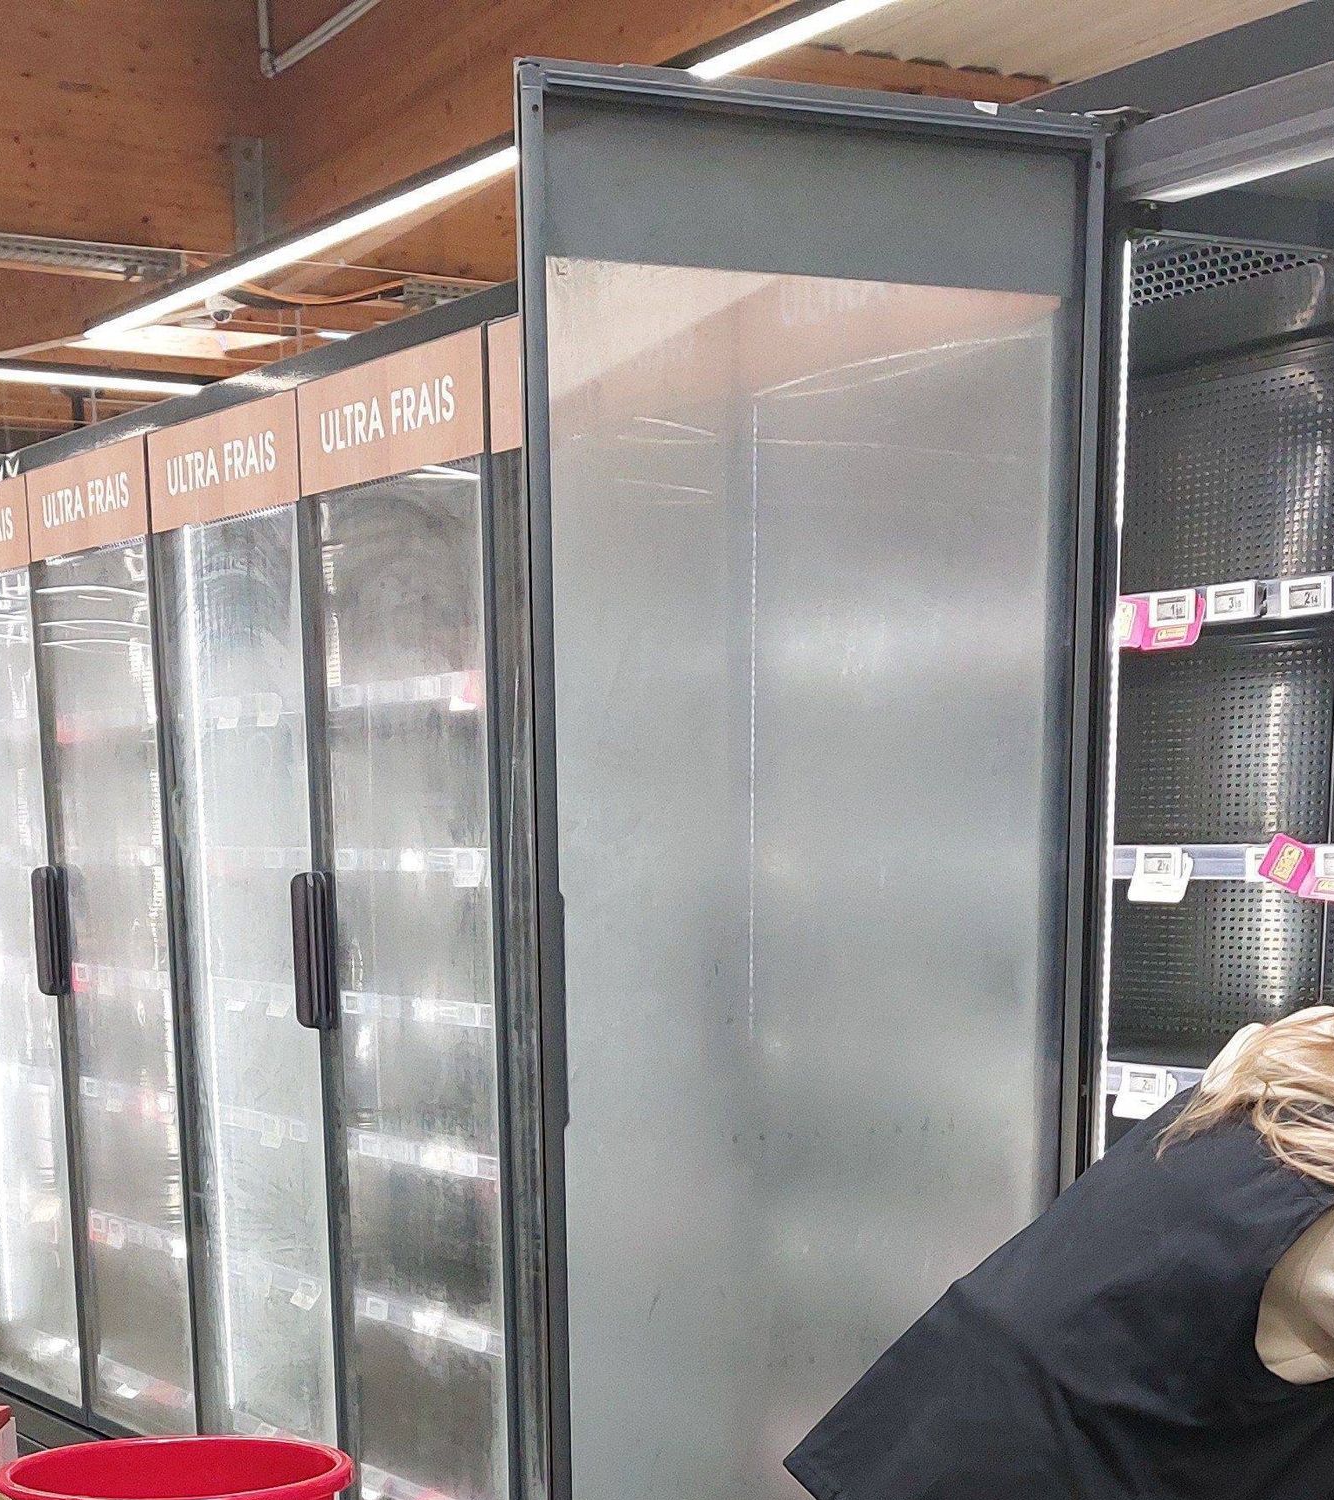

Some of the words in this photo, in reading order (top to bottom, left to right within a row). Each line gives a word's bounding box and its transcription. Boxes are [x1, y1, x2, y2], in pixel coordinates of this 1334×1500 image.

[320, 397, 385, 454] ULTRA
[390, 374, 456, 433] FRAIS
[166, 449, 221, 496] ULTRA
[223, 431, 276, 481] FRAIS
[42, 486, 85, 529] ULTRA
[87, 471, 129, 515] FRAIS
